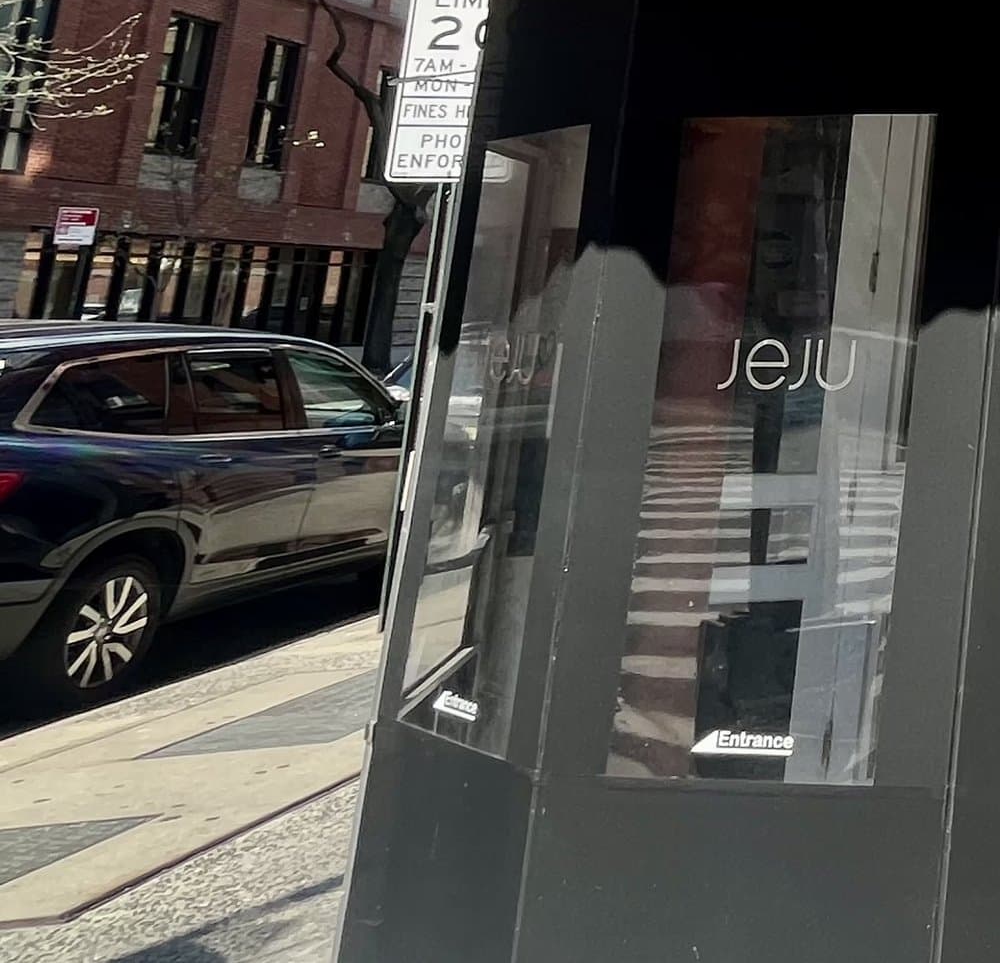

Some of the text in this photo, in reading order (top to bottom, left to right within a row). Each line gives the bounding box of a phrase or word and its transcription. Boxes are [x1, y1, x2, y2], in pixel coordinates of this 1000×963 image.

[414, 58, 454, 72] 7AM
[414, 79, 457, 92] MON
[403, 104, 447, 118] FINES
[718, 730, 795, 749] Entrance
